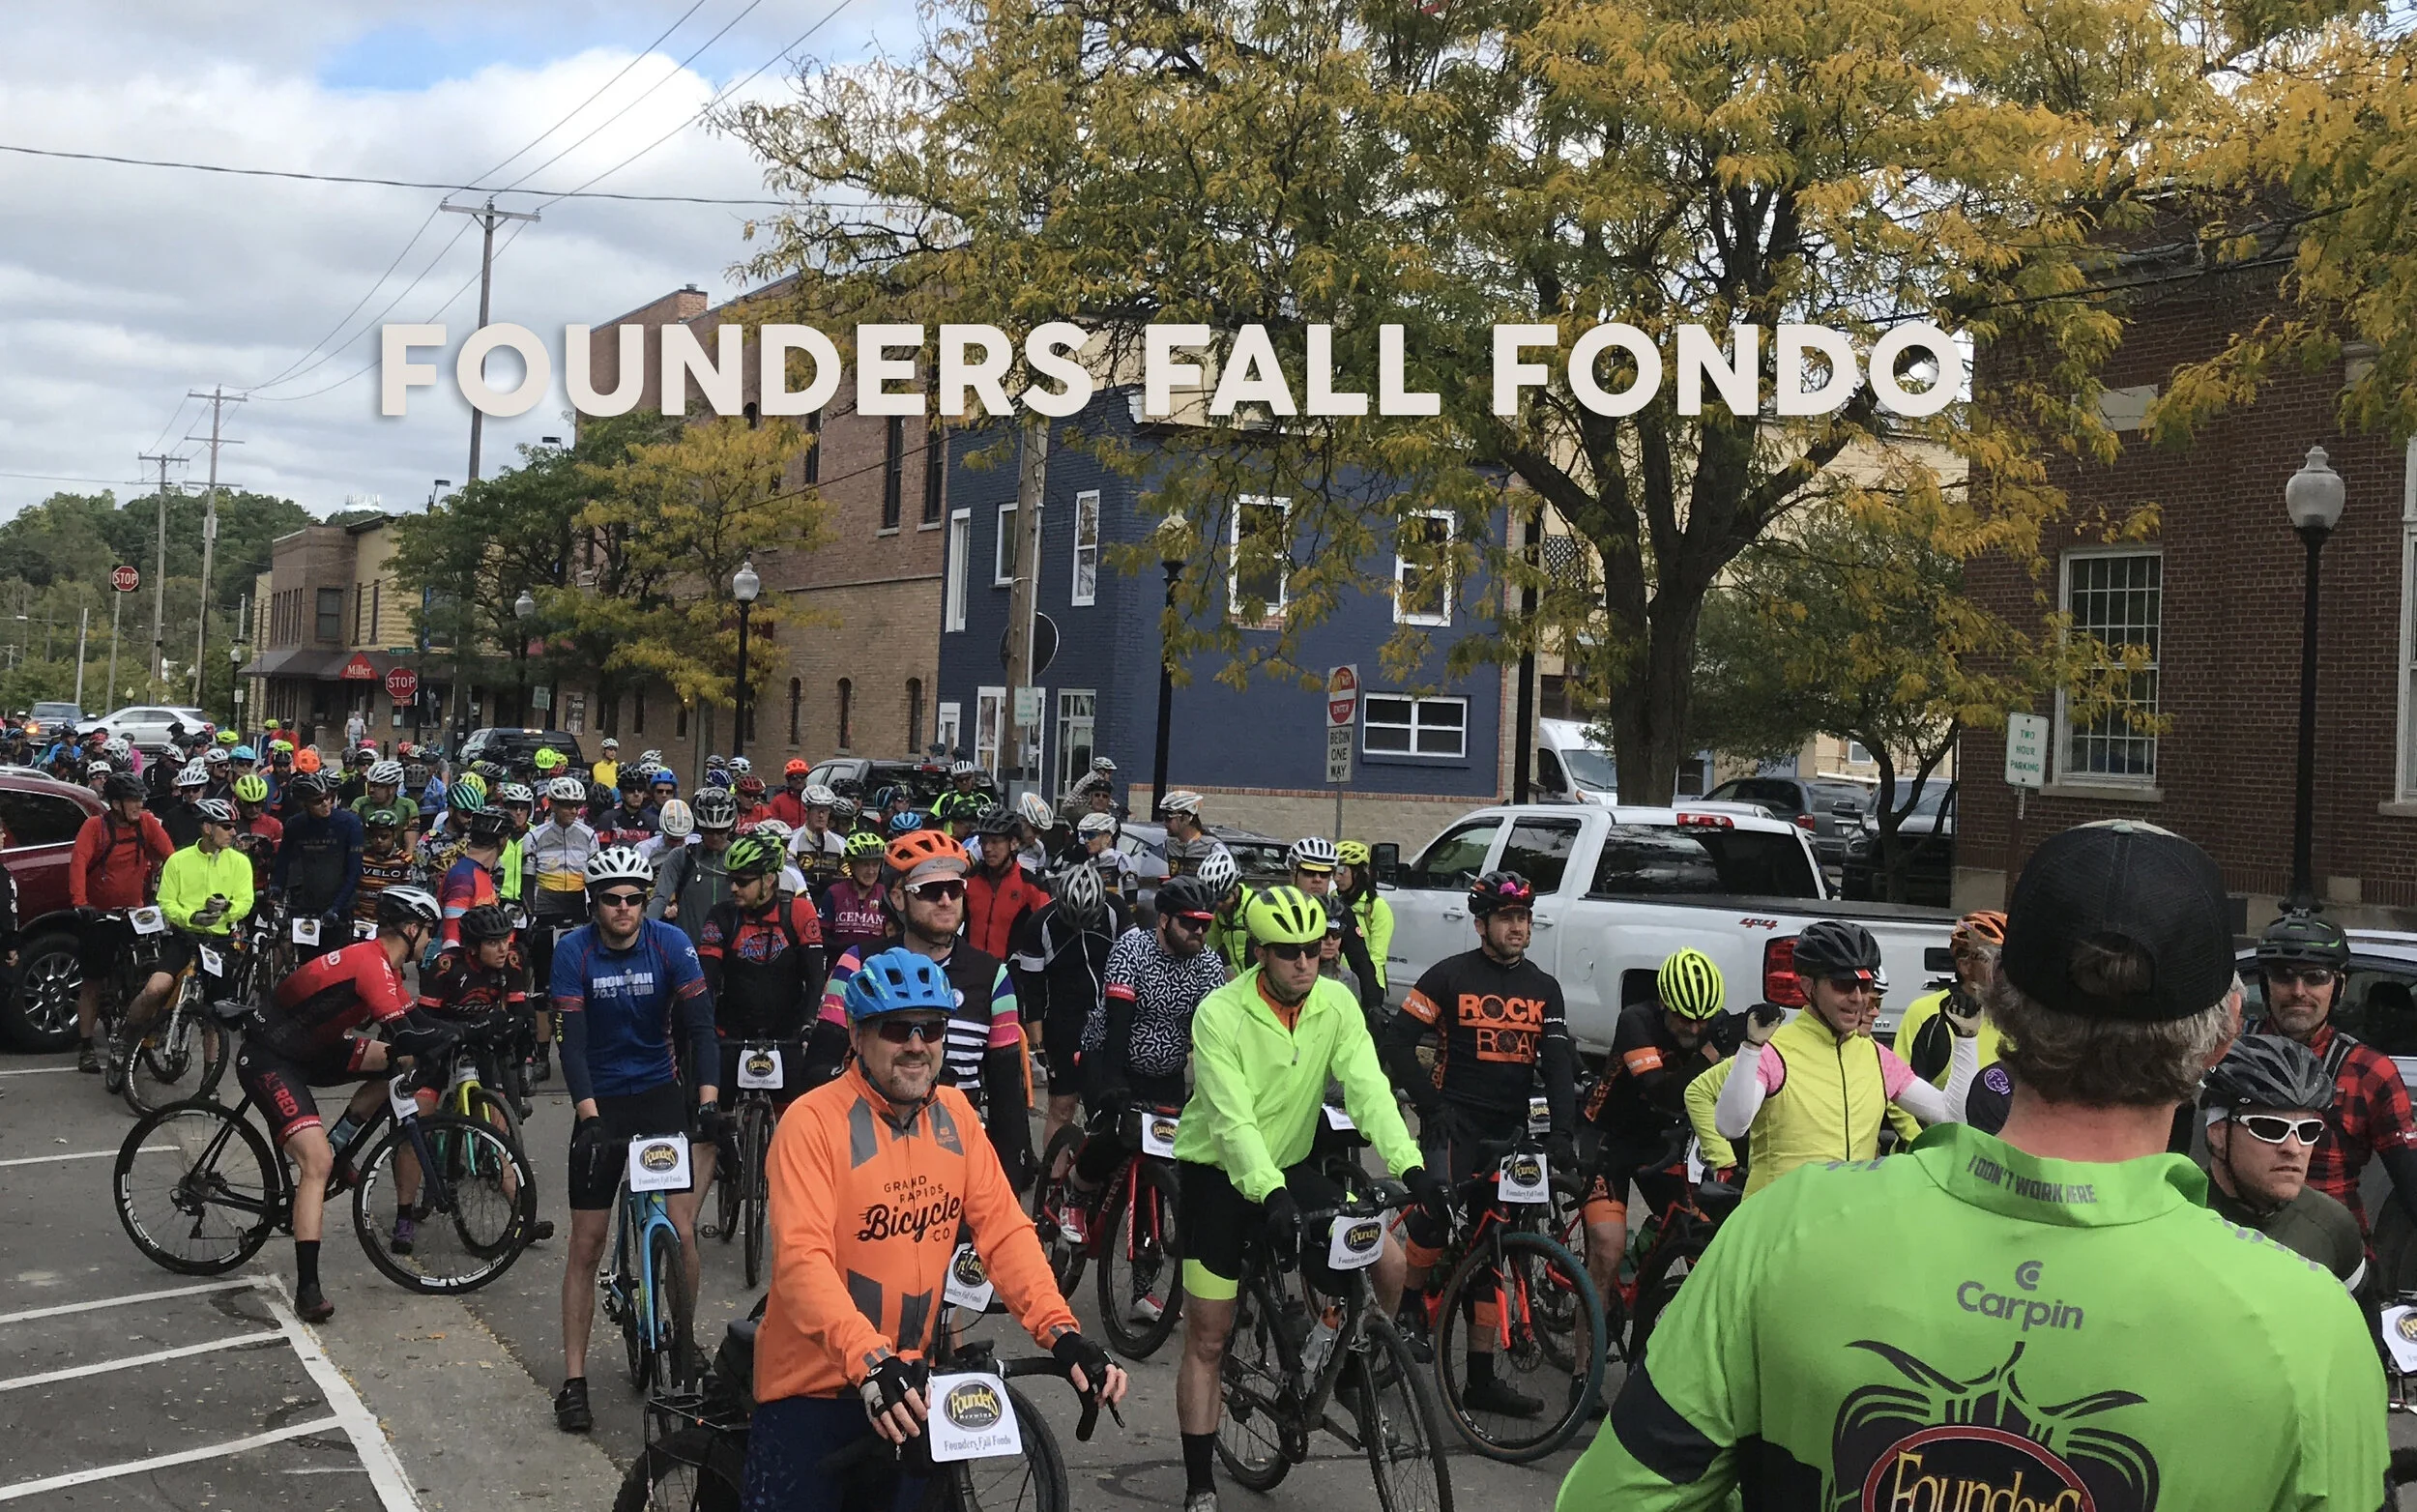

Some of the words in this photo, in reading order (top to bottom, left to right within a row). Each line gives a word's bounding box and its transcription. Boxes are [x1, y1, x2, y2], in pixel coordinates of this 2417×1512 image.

[114, 572, 137, 585] STOP
[347, 664, 372, 676] Miller
[388, 676, 416, 688] STOP
[1329, 730, 1351, 745] BEGIN
[2020, 729, 2035, 740] TWO
[1330, 747, 1348, 761] ONE
[2015, 744, 2036, 756] HOUR
[1330, 764, 1347, 777] WAY
[2010, 759, 2039, 772] PARKING
[363, 867, 401, 878] VELO
[593, 972, 655, 989] IRONMAN
[593, 986, 618, 999] 70.3
[1458, 994, 1546, 1024] ROCK
[644, 1147, 676, 1166] Founders
[884, 1175, 927, 1193] GRAND
[1966, 1154, 1978, 1173] I
[1974, 1157, 2015, 1191] DON'T
[2015, 1175, 2063, 1204] WORK
[2066, 1182, 2098, 1205] HERE
[899, 1182, 944, 1204] RAPIDS
[856, 1192, 961, 1243] Bicycle
[1956, 1280, 2084, 1332] Carpin
[950, 1387, 1000, 1419] Founders
[1890, 1448, 2082, 1512] Found
